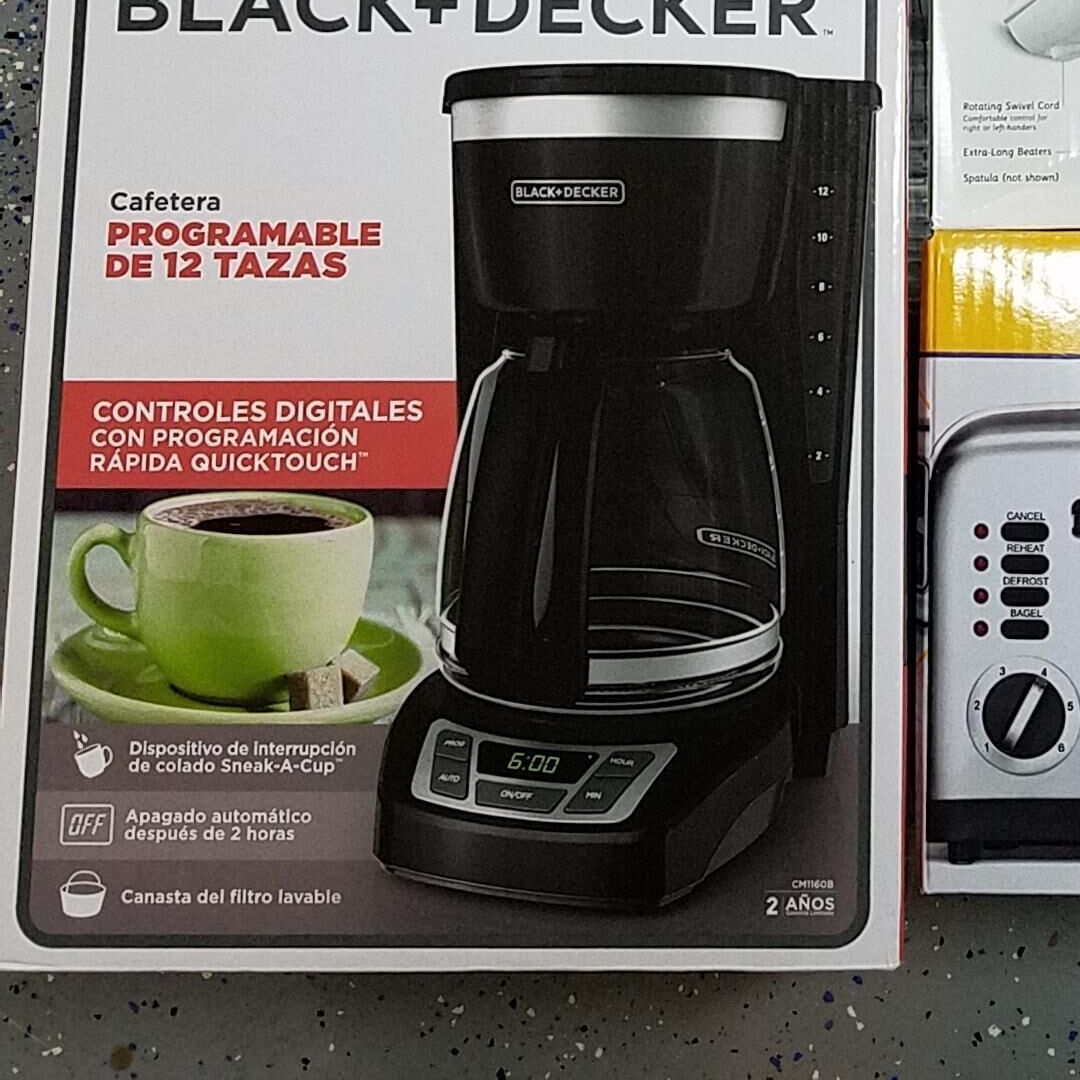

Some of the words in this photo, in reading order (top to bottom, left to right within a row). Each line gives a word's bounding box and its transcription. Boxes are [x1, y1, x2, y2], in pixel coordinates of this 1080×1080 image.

[963, 102, 1001, 112] Rotating
[1006, 102, 1034, 110] Swivel
[1038, 101, 1060, 110] Cord
[963, 148, 1013, 158] Extra-Long
[1018, 148, 1051, 156] Beaters
[963, 174, 999, 183] Spatula
[1003, 173, 1021, 182] (not
[1026, 173, 1059, 182] shown)
[516, 186, 618, 198] BLACK+DECKER
[110, 191, 221, 213] Cafetera
[107, 222, 382, 248] PROGRAMABLE
[105, 253, 153, 279] DE
[162, 252, 201, 278] 12
[212, 252, 347, 279] TAZAS
[93, 401, 266, 422] CONTROLES
[275, 400, 423, 422] DIGITALES
[91, 428, 145, 447] CON
[153, 423, 358, 446] PROGRAMACIÓN
[90, 449, 183, 472] RÁPIDA
[1007, 512, 1045, 520] CANCEL
[1007, 544, 1044, 552] REHEAT
[1003, 577, 1049, 585] DEFROST
[1010, 609, 1042, 617] BAGEL
[508, 752, 560, 774] 6:00
[792, 880, 833, 888] CM1160B
[122, 890, 191, 904] Canasta
[197, 889, 224, 904] del
[230, 889, 272, 904] filtro
[278, 889, 341, 904] lavable
[766, 896, 778, 915] 2
[785, 894, 835, 910] AÑOS
